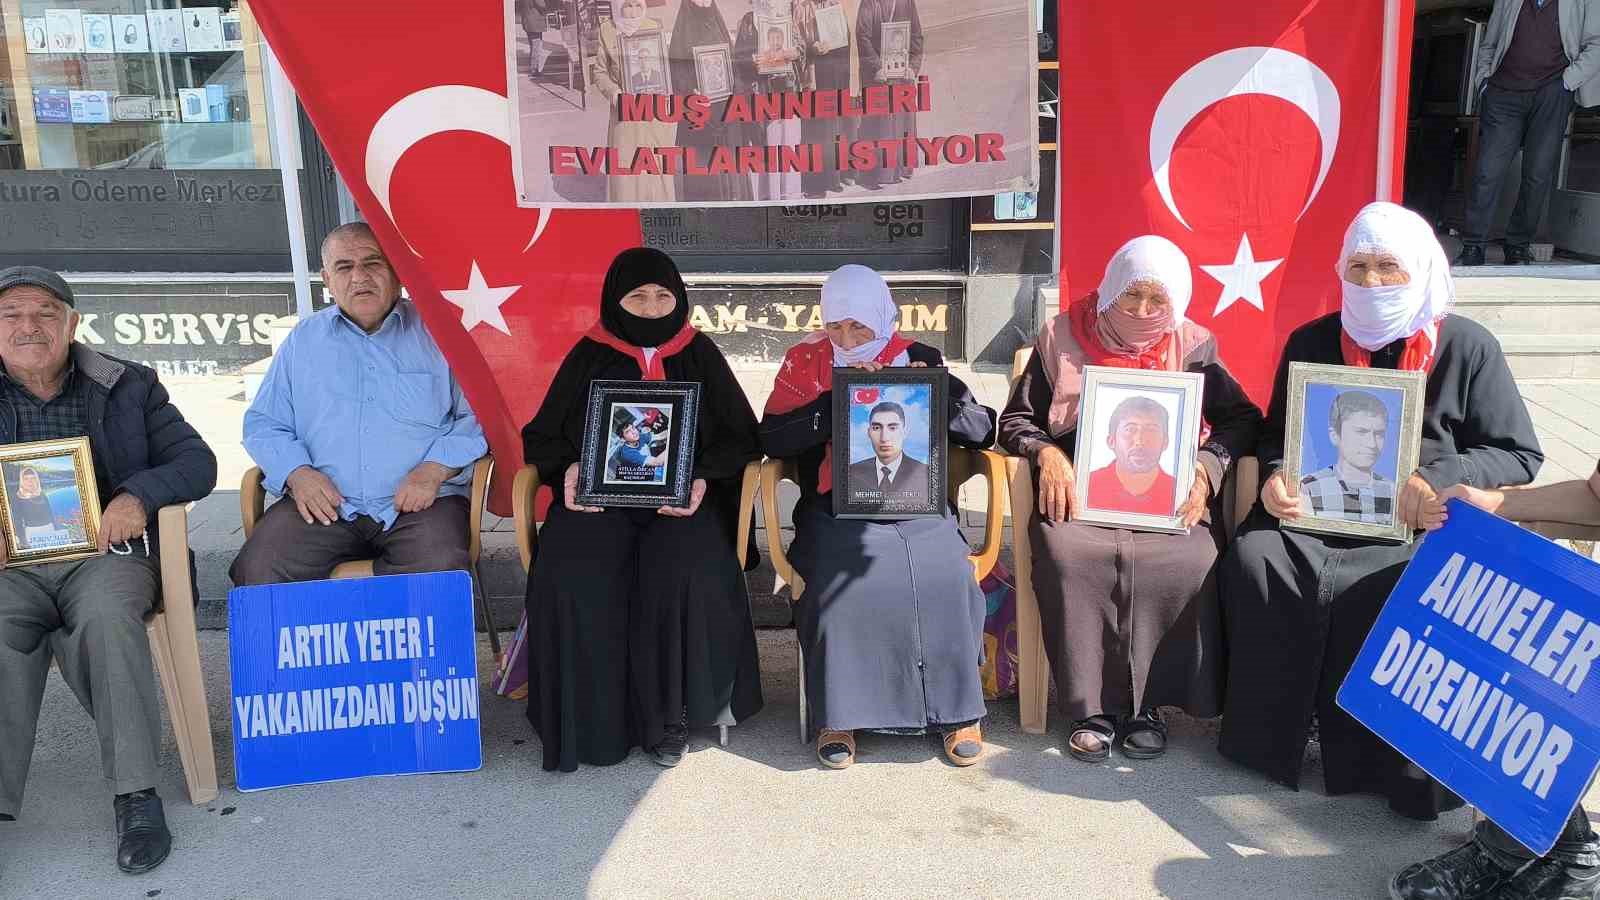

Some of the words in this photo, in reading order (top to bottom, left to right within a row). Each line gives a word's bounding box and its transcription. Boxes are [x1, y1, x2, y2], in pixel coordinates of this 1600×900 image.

[618, 92, 711, 131] MUŞ
[721, 75, 932, 122] ANNELERİ
[549, 144, 823, 177] EVLATLARINI
[836, 132, 1005, 172] İSTİYOR
[71, 174, 167, 202] Ödeme
[643, 231, 699, 249] eşitleri
[689, 304, 748, 333] AM
[277, 622, 350, 669] ARTIK
[354, 617, 422, 662] YETER
[1418, 552, 1600, 694] ANNELER
[235, 683, 396, 739] YAKAMIZDAN
[402, 666, 478, 735] DÜŞÜN
[1370, 624, 1574, 800] DİRENİYOR
